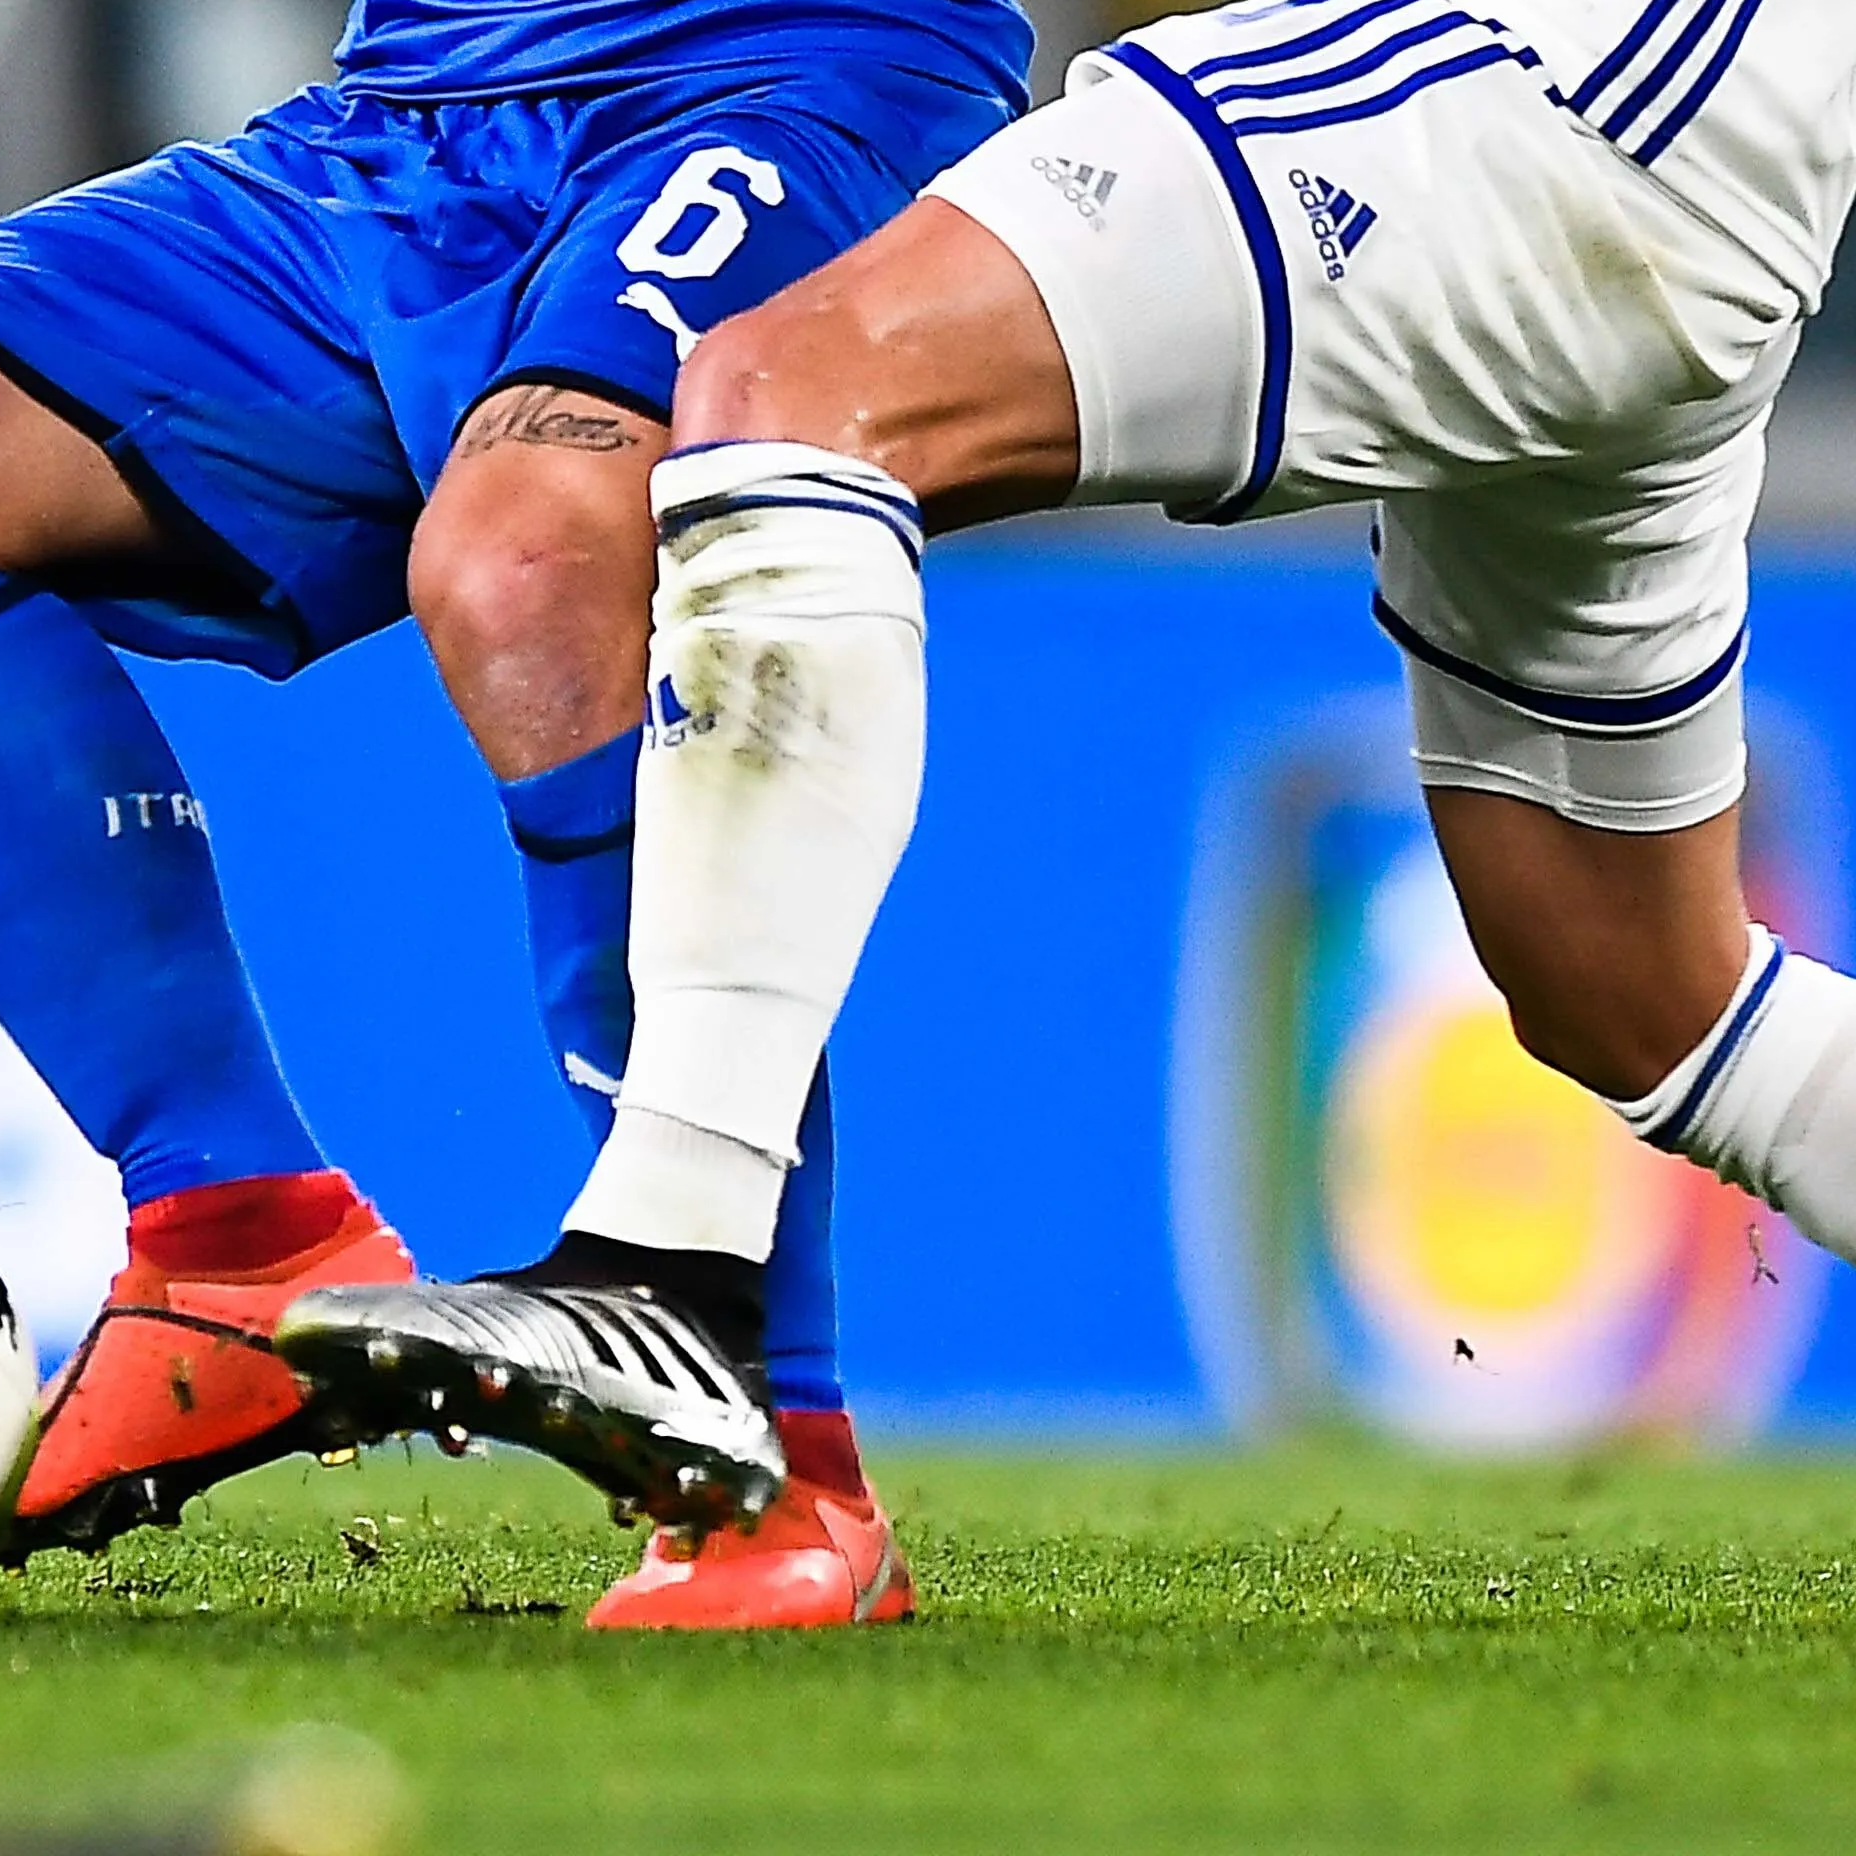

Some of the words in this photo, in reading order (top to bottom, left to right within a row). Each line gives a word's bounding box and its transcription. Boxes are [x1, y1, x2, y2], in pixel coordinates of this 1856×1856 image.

[615, 145, 785, 279] 6
[1031, 156, 1107, 232] adidas
[1289, 169, 1345, 282] adidas
[102, 792, 210, 838] ITA
